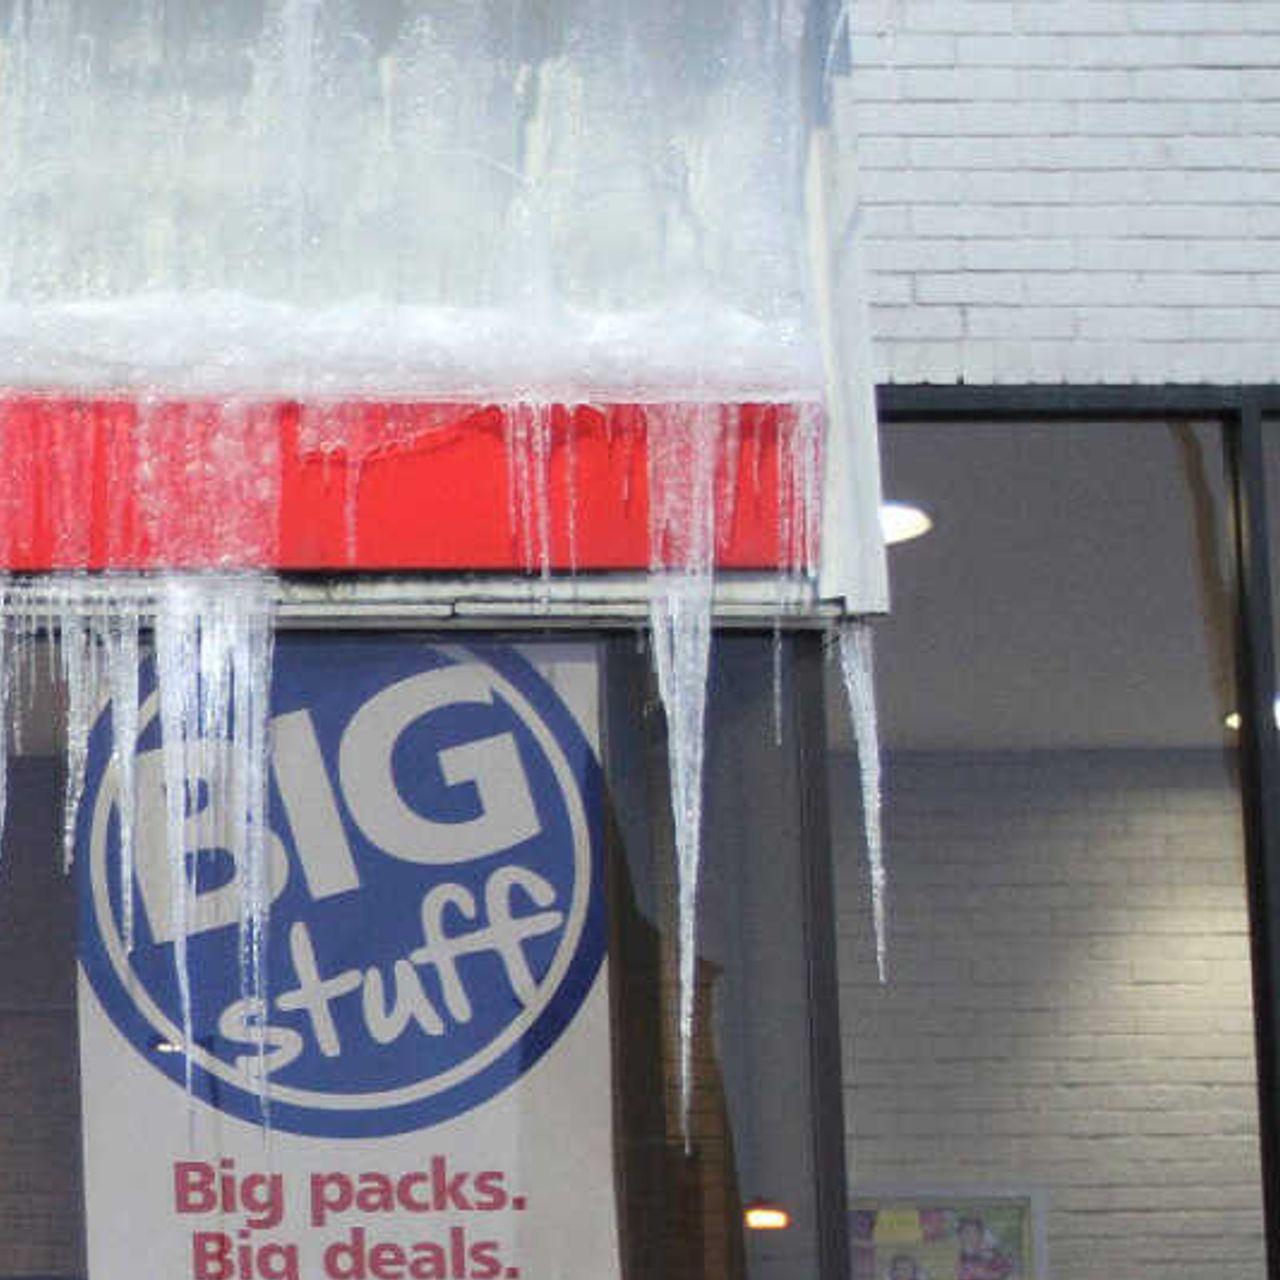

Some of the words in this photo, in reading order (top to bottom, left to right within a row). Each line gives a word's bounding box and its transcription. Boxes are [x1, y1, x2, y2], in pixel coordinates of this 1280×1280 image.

[139, 664, 543, 945] BIG
[217, 865, 564, 1073] stuff
[172, 1158, 284, 1230] Big
[310, 1155, 527, 1227] packs.
